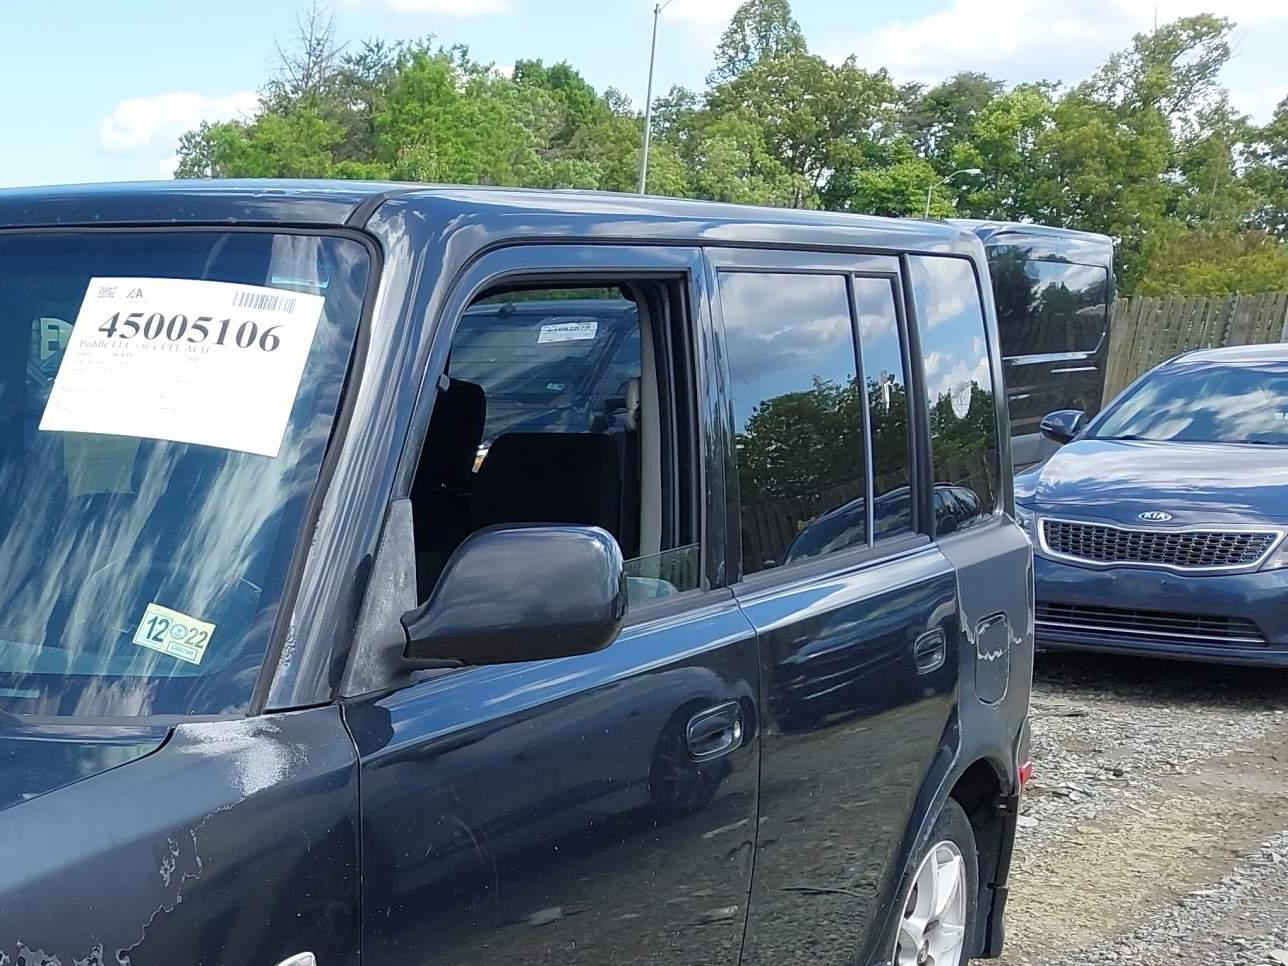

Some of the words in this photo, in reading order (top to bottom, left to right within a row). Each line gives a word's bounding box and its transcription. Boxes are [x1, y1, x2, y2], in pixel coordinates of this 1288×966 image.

[98, 312, 284, 353] 45005106
[1142, 510, 1168, 520] KIA
[146, 616, 170, 642] 12
[184, 628, 208, 648] 22
